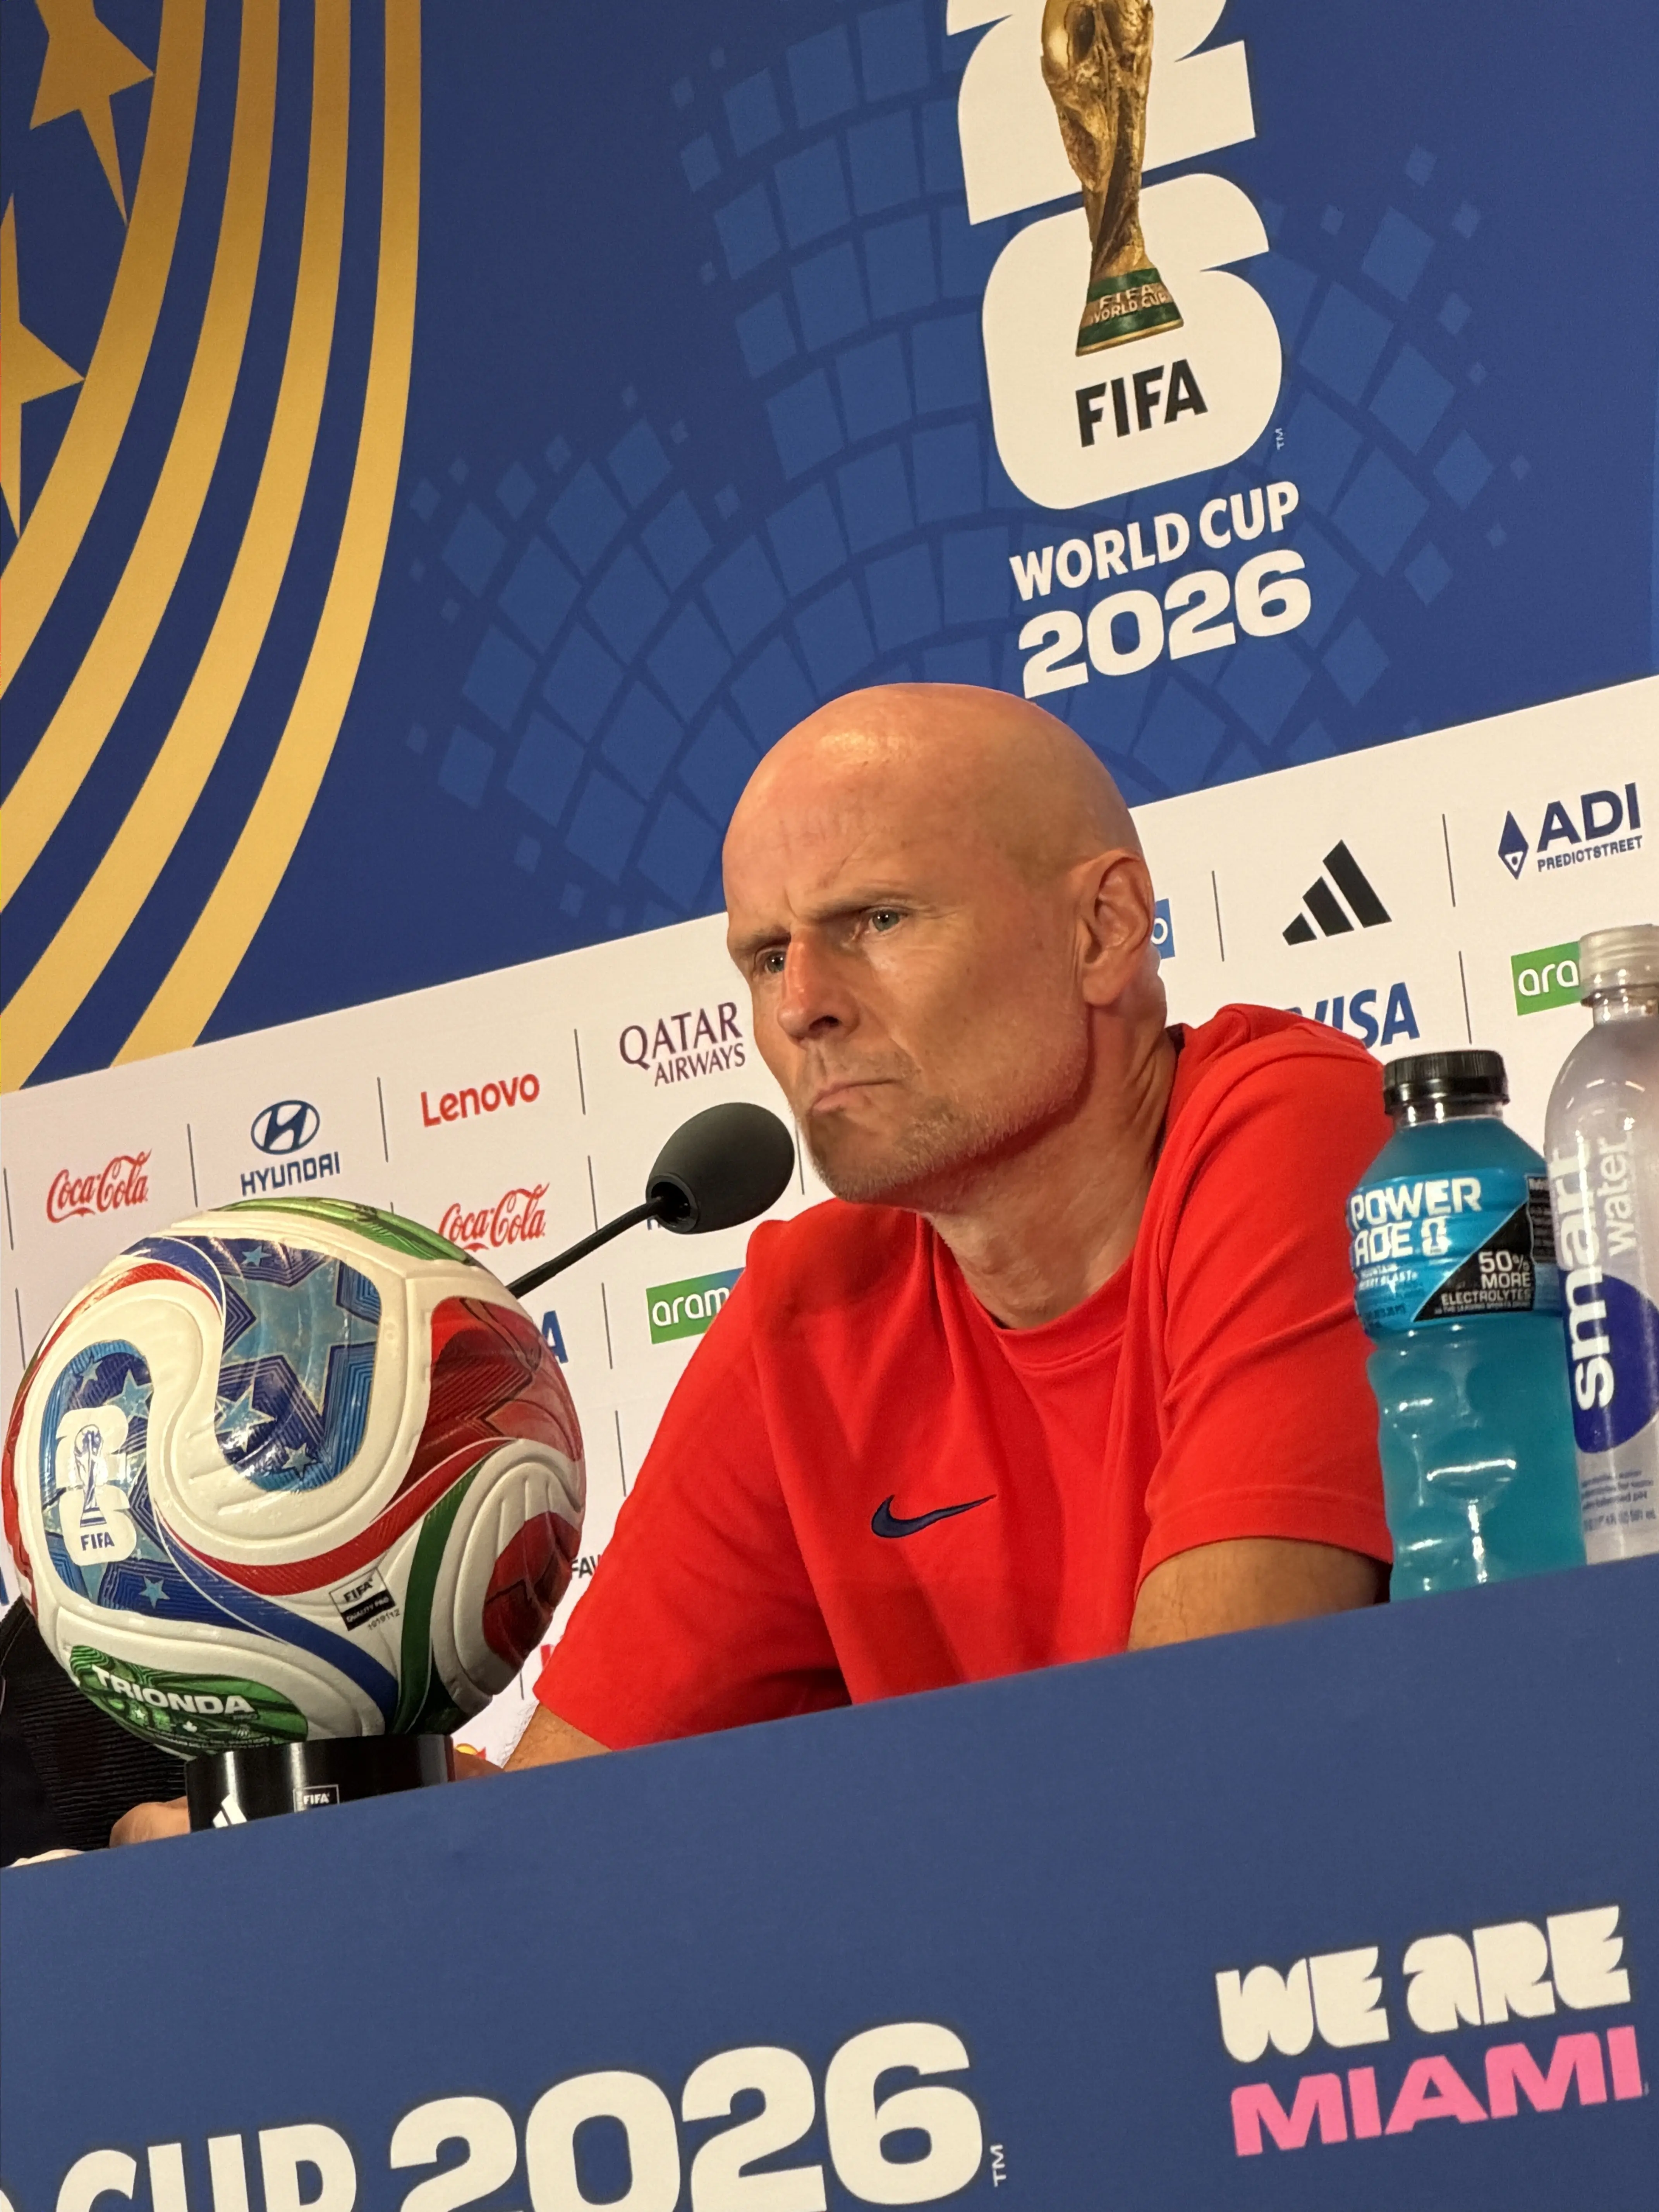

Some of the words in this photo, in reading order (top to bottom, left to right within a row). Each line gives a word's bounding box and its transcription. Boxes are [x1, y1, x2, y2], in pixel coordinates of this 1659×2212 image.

[1099, 285, 1153, 309] FIFA
[1075, 359, 1208, 448] FIFA
[1009, 512, 1190, 601] WORLD
[1199, 481, 1299, 548] CUP
[1018, 550, 1311, 699] 2026
[1537, 782, 1641, 853] ADI
[1537, 835, 1643, 872] PREDICTSTREET
[1518, 960, 1580, 996] ara
[619, 1001, 743, 1071] QATAR
[654, 1042, 746, 1087] AIRWAYS
[420, 1073, 541, 1128] Lenovo
[46, 1148, 152, 1224] Coca-Cola
[240, 1151, 341, 1197] HYUNDAI
[1597, 1135, 1638, 1257] water
[1351, 1177, 1482, 1231] POWER
[1479, 1250, 1530, 1273] 50%
[1481, 1272, 1531, 1289] MORE
[1549, 1140, 1615, 1412] smart
[652, 1287, 730, 1327] aram
[1441, 1288, 1531, 1306] ELECTROLYTES
[81, 1532, 115, 1551] FIFA
[343, 1581, 373, 1602] FIFA
[92, 1664, 255, 1714] TRIONDA
[303, 1793, 329, 1805] FIFA
[1216, 1946, 1389, 2062] WE
[1403, 1905, 1631, 2033] ARE
[390, 2022, 982, 2212] 2026
[1231, 2026, 1642, 2156] MIAMI
